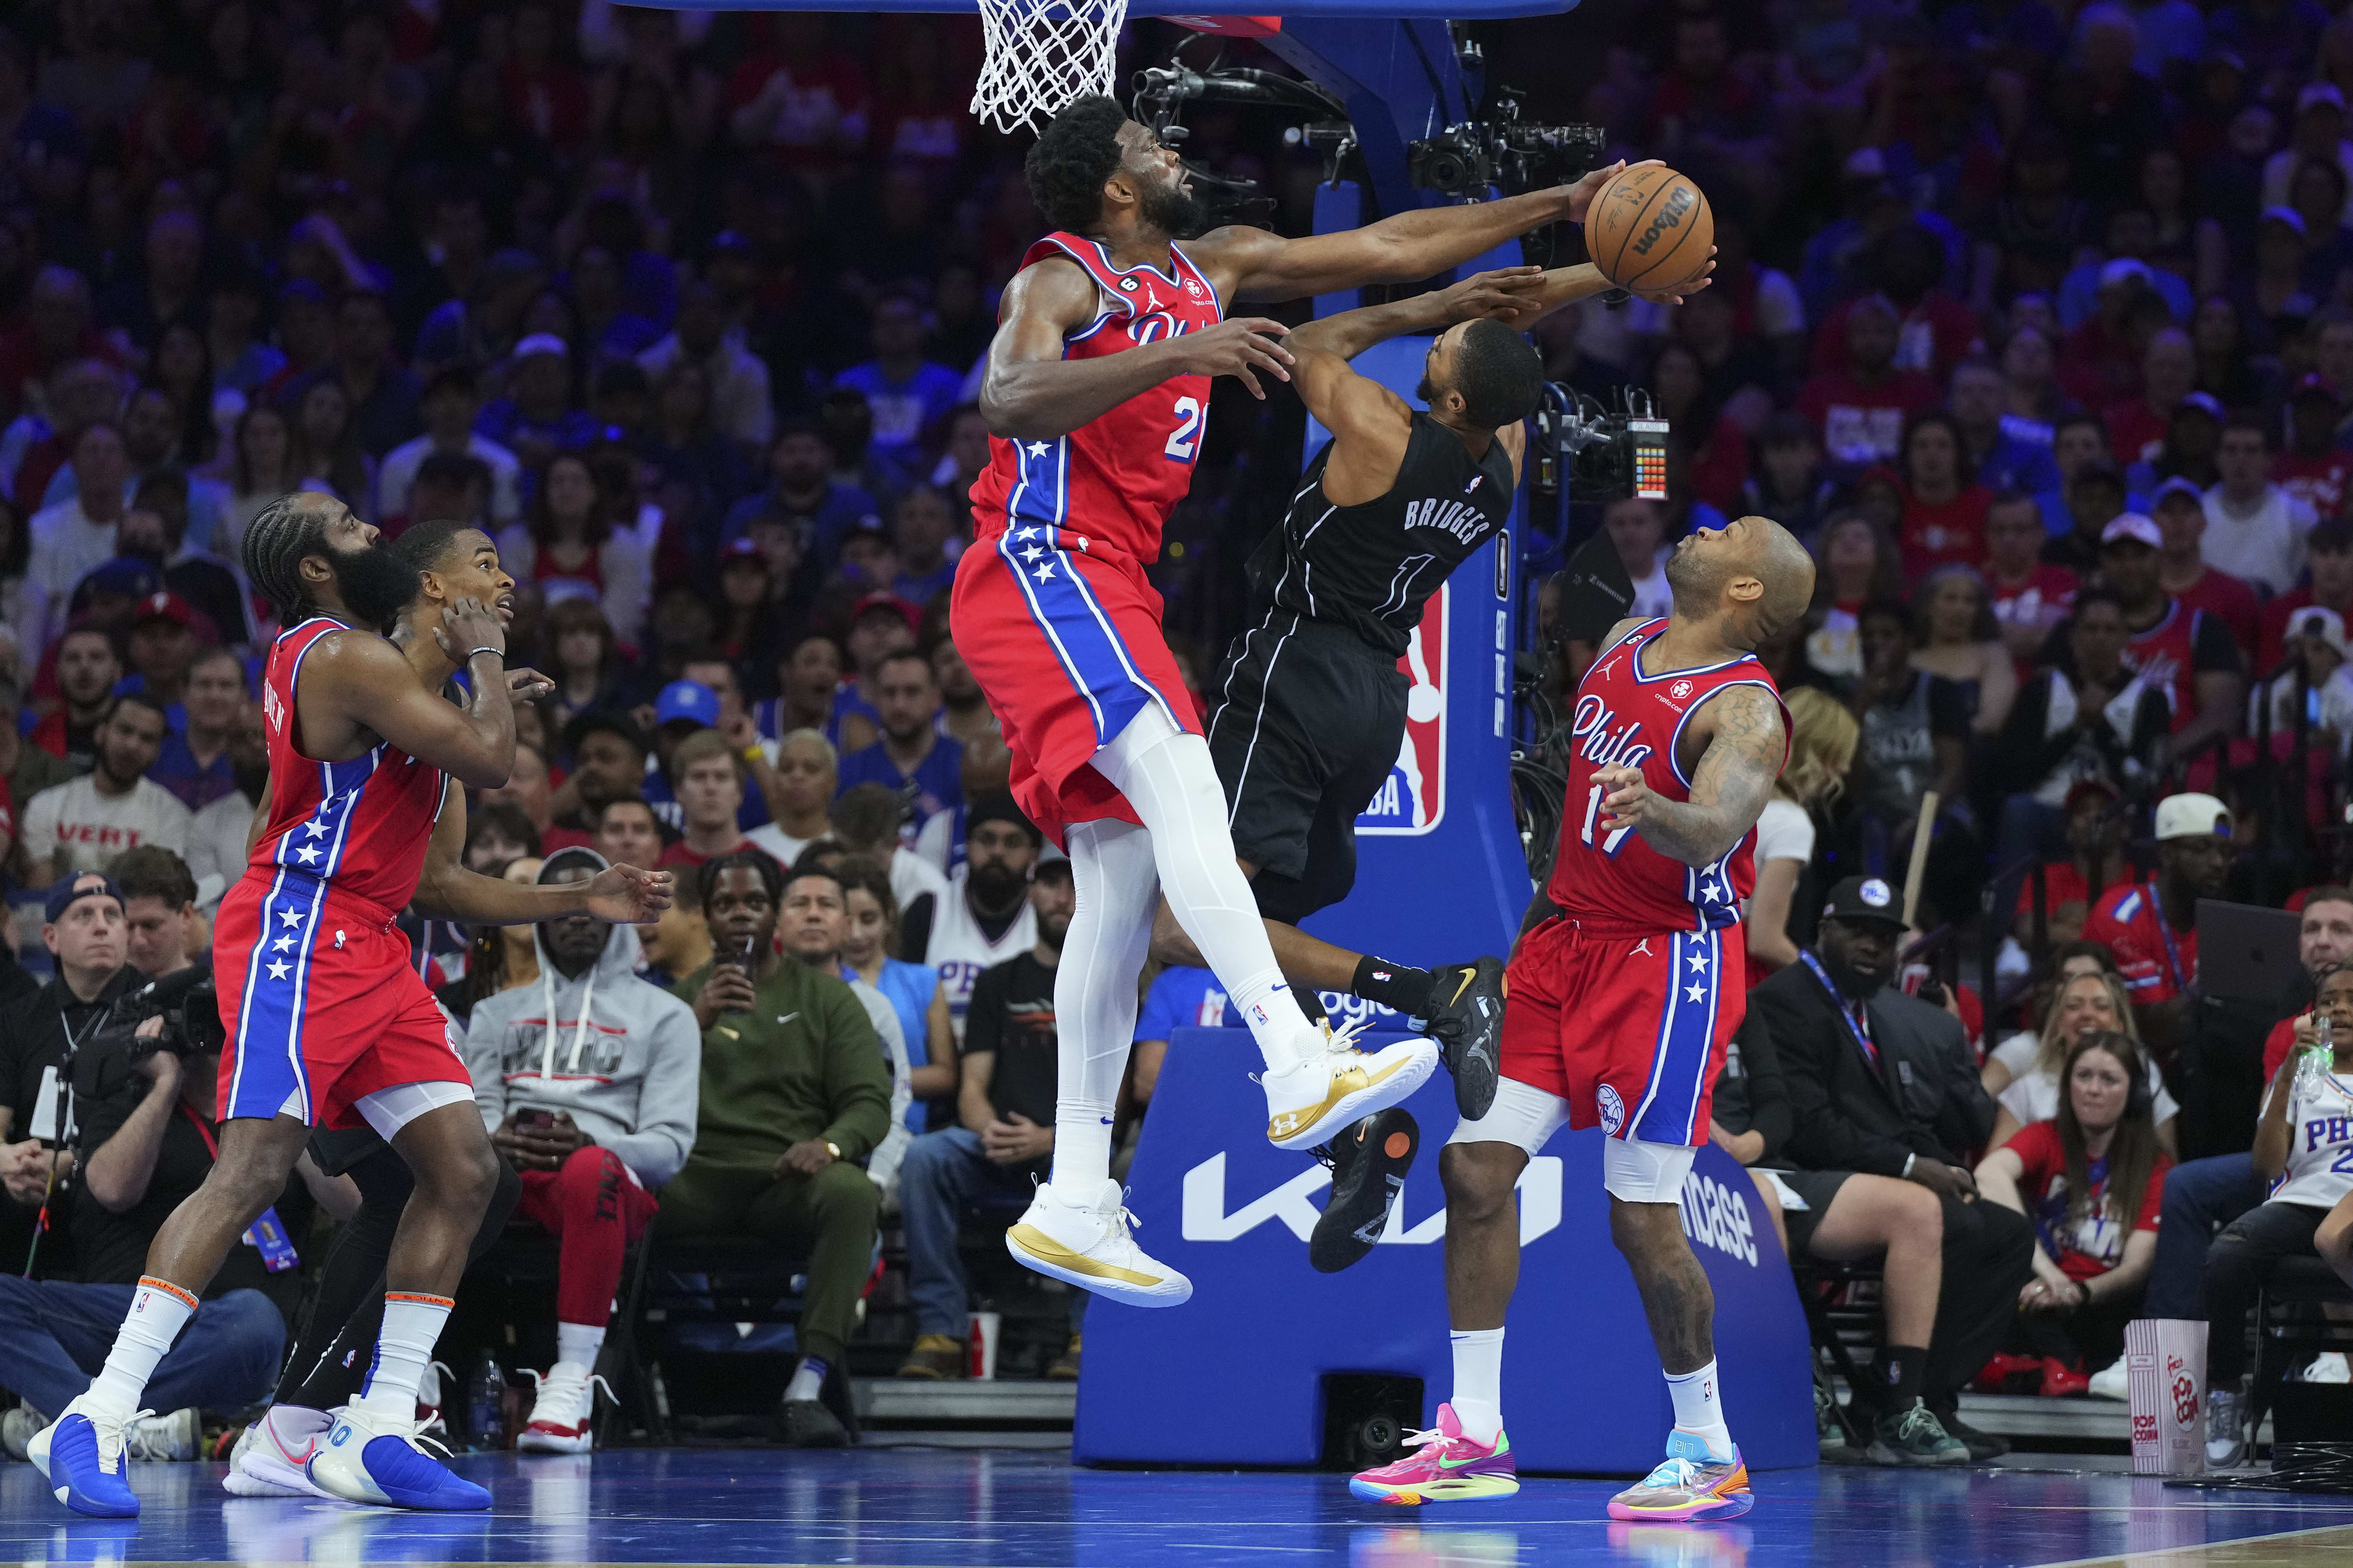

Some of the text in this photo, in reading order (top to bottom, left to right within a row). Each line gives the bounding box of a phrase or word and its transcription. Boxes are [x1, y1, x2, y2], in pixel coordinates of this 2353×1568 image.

[1632, 186, 1694, 255] Wilson
[1120, 278, 1138, 291] 6
[1404, 498, 1489, 545] BRIDGES
[1371, 553, 1435, 620] 1
[1625, 635, 1644, 645] 6
[1654, 693, 1684, 714] crypto.com
[1572, 694, 1654, 768] Phila
[2133, 1415, 2156, 1429] POP
[2133, 1429, 2158, 1441] CORN
